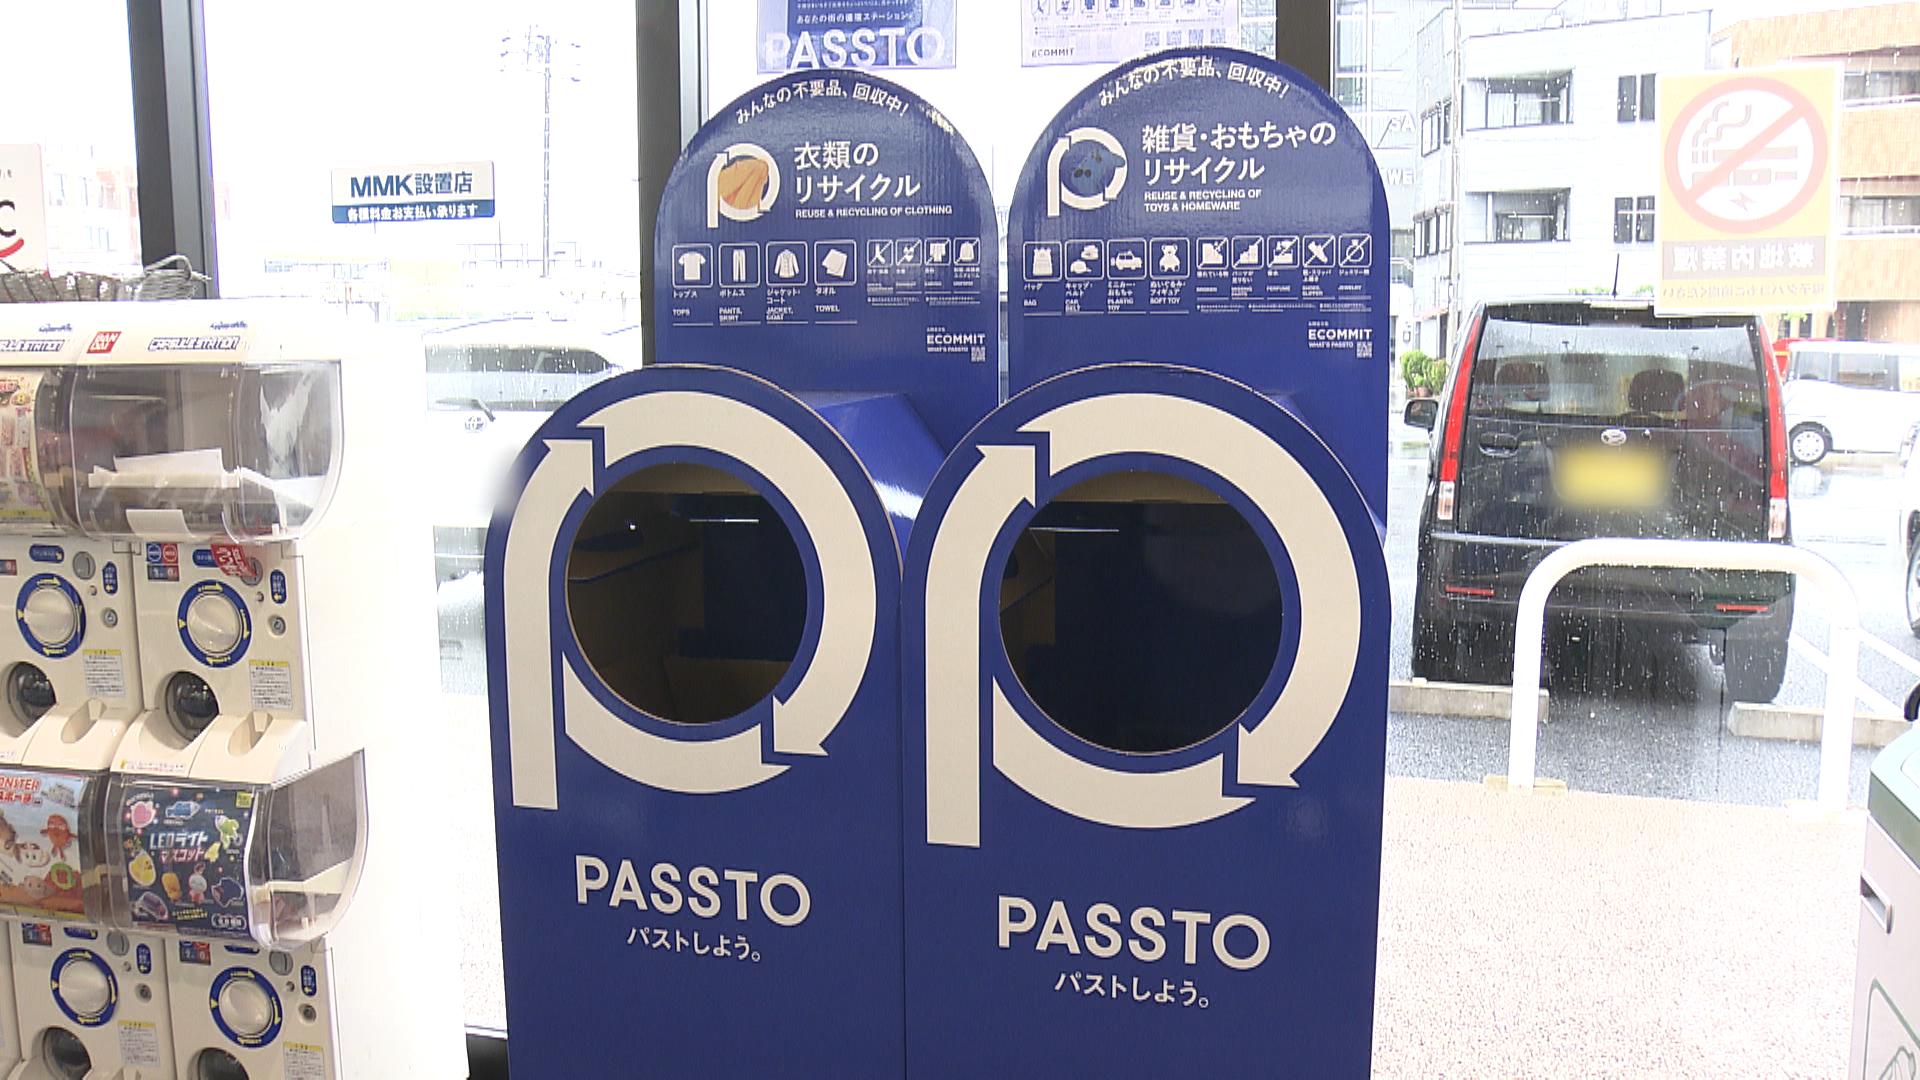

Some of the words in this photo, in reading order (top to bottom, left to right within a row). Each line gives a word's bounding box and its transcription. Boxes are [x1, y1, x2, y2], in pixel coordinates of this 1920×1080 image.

[765, 27, 946, 70] PASSTO
[1031, 48, 1075, 58] ECOMMIT
[1142, 122, 1336, 154] 雑貨・おもちゃの
[794, 141, 879, 170] 衣類の
[350, 171, 473, 198] MMK設置店
[1144, 157, 1265, 185] リサイクル
[796, 175, 921, 203] リサイクル
[1144, 190, 1177, 201] REUSE
[1179, 190, 1187, 200] &
[1189, 189, 1245, 200] RECYCLING
[1248, 189, 1261, 199] OF
[796, 208, 825, 218] REUSE
[827, 208, 834, 217] &
[836, 207, 886, 217] RECYCLING
[890, 207, 901, 216] OF
[904, 205, 953, 216] CLOTHING
[1144, 202, 1168, 212] TOYS
[1169, 202, 1178, 211] &
[1181, 200, 1241, 211] HOMEWARE
[927, 333, 985, 345] ECOMMIT
[1308, 328, 1372, 340] ECOMMIT
[574, 854, 811, 926] PASSTO
[627, 926, 762, 963] パストしよう。
[998, 895, 1271, 971] PASSTO
[1055, 972, 1210, 1008] パストしよう。
